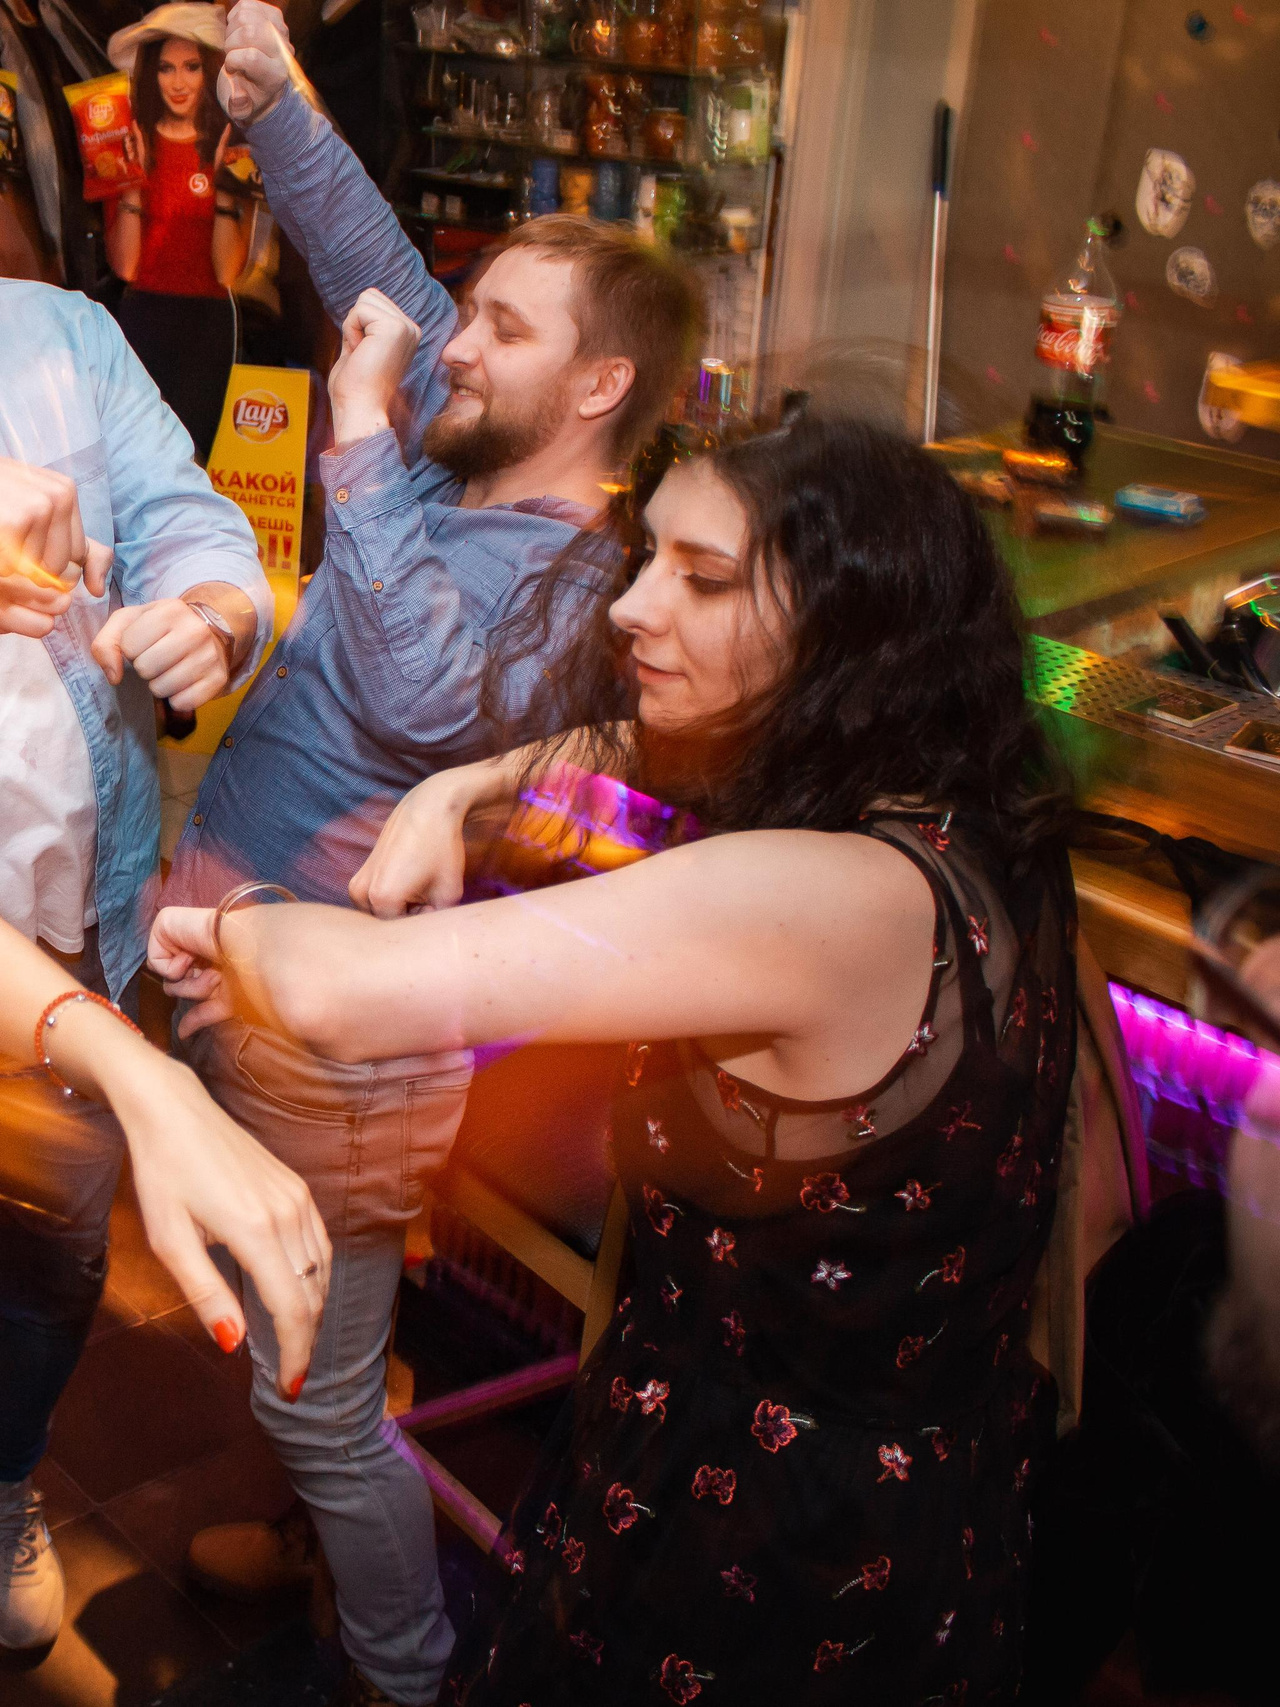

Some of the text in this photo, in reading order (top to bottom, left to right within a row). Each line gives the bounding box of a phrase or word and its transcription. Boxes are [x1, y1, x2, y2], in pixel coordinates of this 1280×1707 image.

[236, 400, 286, 433] Lay's
[210, 468, 296, 495] КАКОЙ
[215, 489, 295, 508] ТАНЕТСЯ
